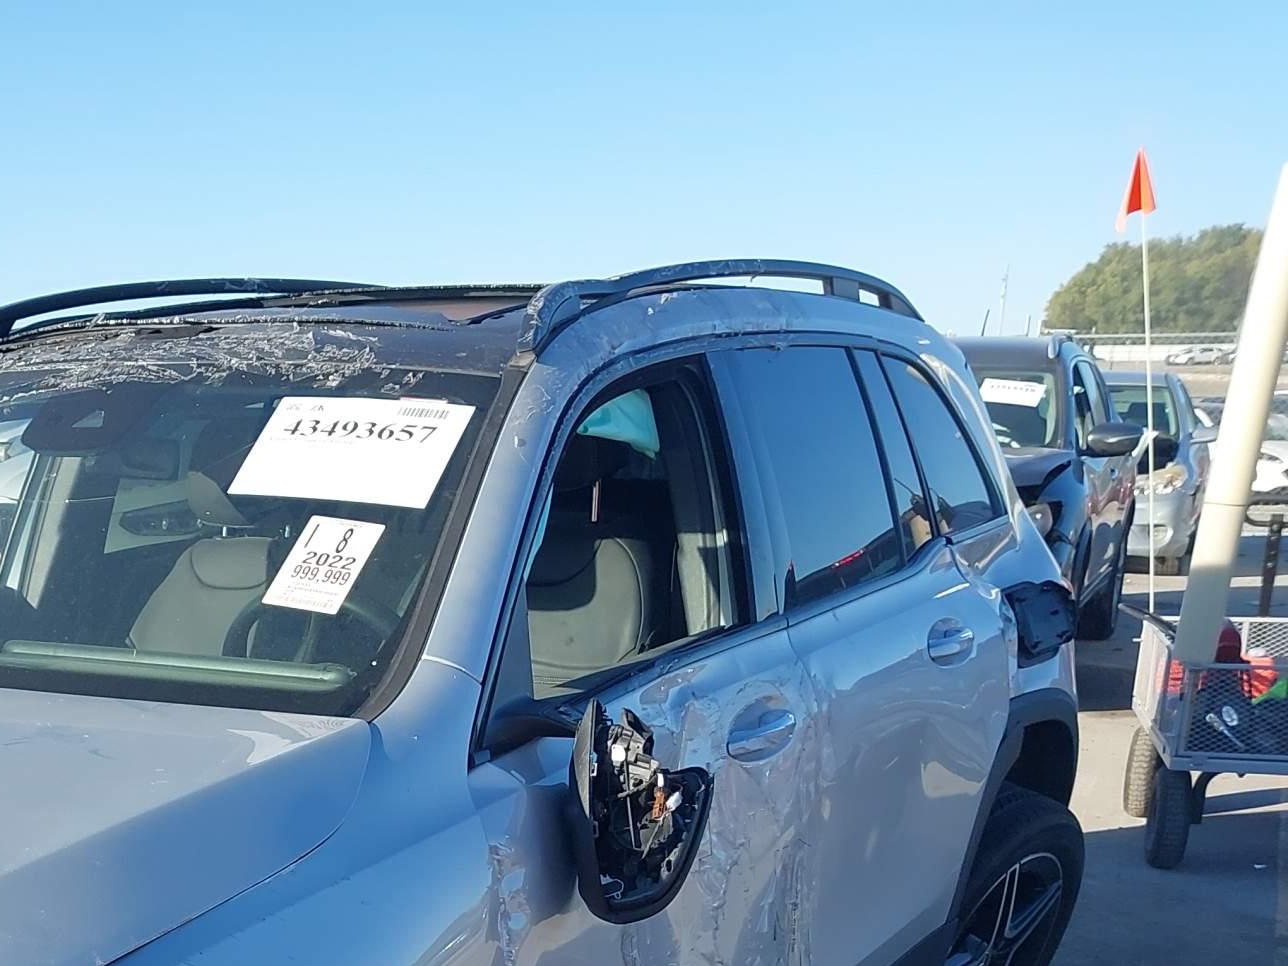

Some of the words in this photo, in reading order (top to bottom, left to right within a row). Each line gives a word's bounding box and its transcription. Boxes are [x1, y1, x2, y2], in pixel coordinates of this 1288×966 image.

[283, 418, 438, 443] 43493657
[336, 528, 354, 554] 8
[302, 551, 357, 571] 2022
[290, 564, 352, 586] 999,999
